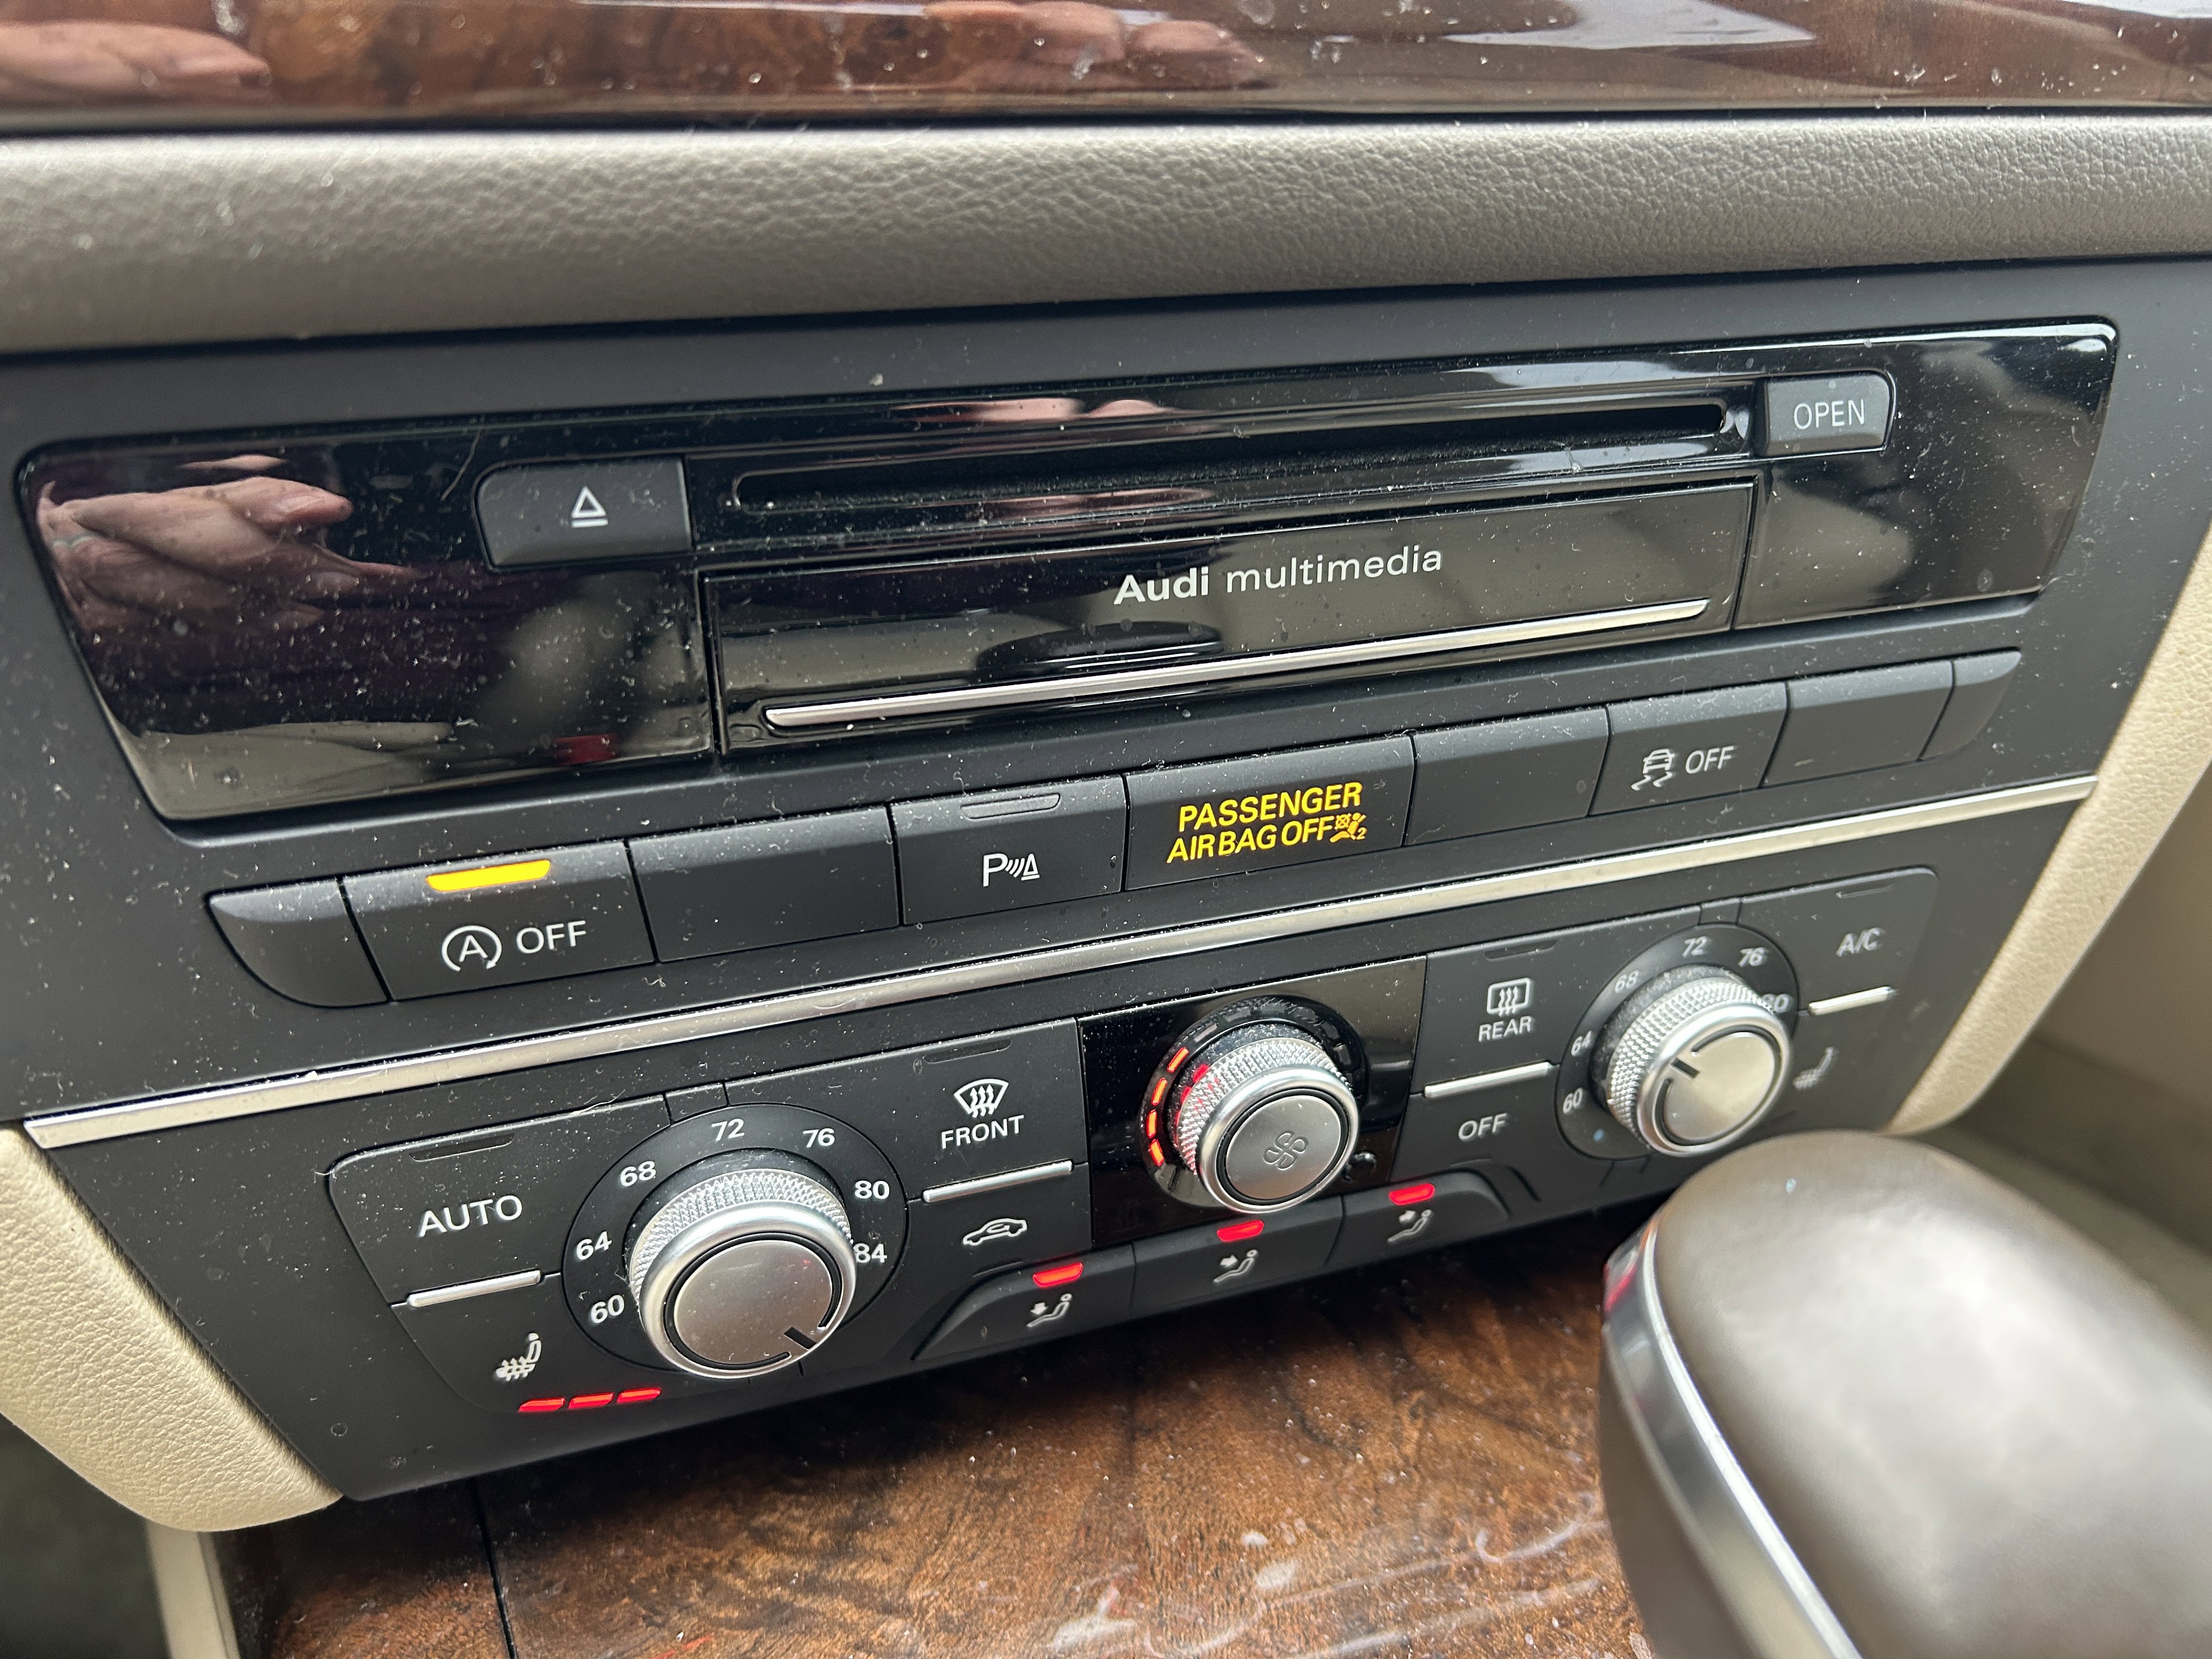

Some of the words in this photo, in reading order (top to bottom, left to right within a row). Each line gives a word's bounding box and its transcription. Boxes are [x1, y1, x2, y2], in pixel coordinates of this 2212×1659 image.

[1793, 399, 1865, 430] OPEN
[1113, 566, 1209, 605] Audi
[1226, 545, 1442, 593] multimedia
[1685, 745, 1736, 775] OFF
[1178, 782, 1363, 832] PASSENGER
[1281, 815, 1335, 847] OFF
[516, 920, 587, 954] OFF
[1682, 936, 1709, 958] 72
[1835, 927, 1884, 957] A/C
[1738, 946, 1768, 968] 76
[1614, 970, 1640, 992] 68
[1477, 1015, 1532, 1043] REAR
[1570, 1030, 1593, 1057] 64
[1562, 1087, 1584, 1115] 60
[710, 1118, 746, 1142] 72
[802, 1127, 836, 1148] 76
[940, 1114, 1025, 1150] FRONT
[1458, 1113, 1508, 1142] OFF
[619, 1160, 657, 1187] 68
[854, 1180, 890, 1200] 80
[417, 1194, 523, 1238] AUTO
[575, 1231, 613, 1261] 64
[854, 1242, 888, 1264] 84
[590, 1294, 625, 1324] 60
